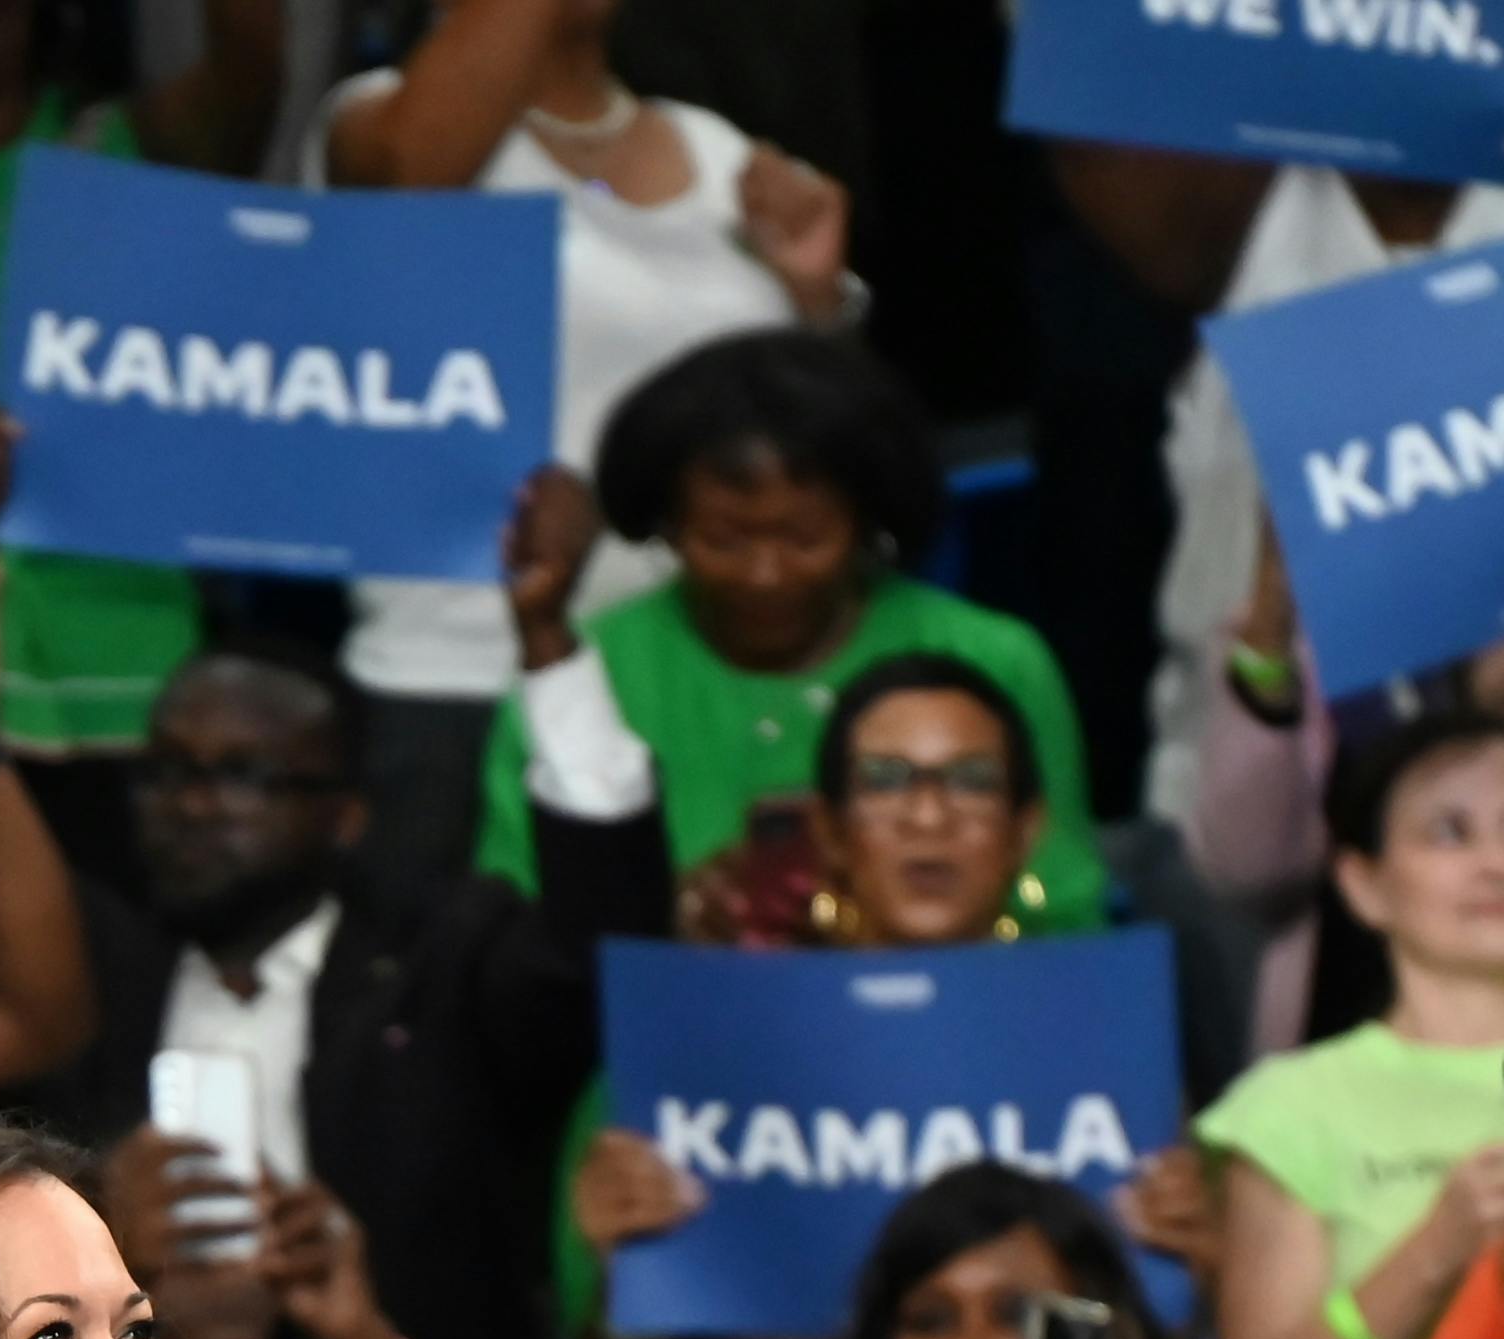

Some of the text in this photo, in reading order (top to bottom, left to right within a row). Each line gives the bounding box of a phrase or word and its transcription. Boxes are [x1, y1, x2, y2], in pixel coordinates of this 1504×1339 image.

[1301, 0, 1502, 65] WIN.
[24, 312, 505, 428] KAMALA
[655, 1094, 1132, 1187] KAMALA
